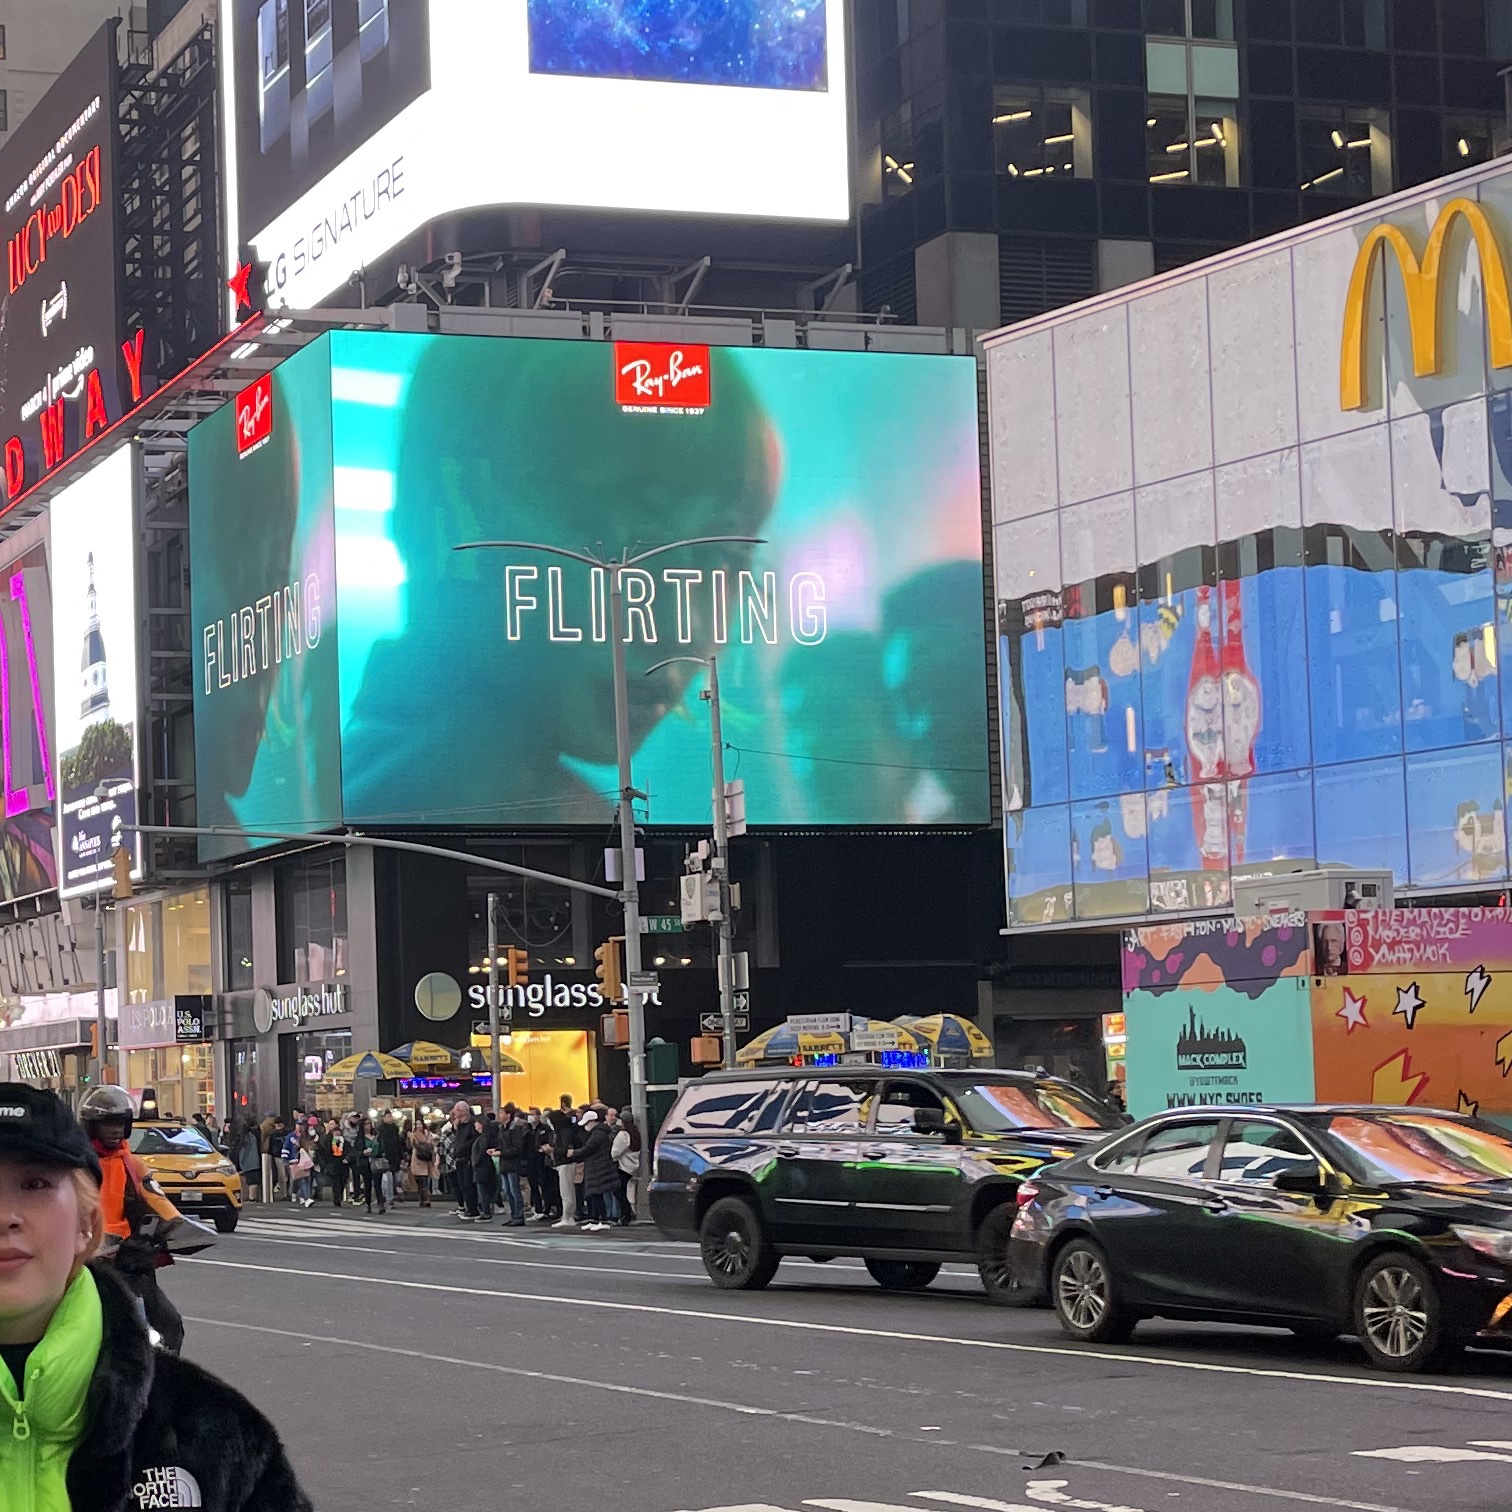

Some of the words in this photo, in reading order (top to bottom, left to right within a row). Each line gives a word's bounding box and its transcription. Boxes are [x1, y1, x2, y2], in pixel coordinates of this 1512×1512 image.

[56, 95, 100, 154] DOCUMENTARY
[7, 202, 46, 295] LUCY
[60, 145, 101, 239] DESI
[293, 155, 405, 276] SIGNATURE
[504, 565, 829, 647] FLIRTING
[203, 572, 321, 696] FLIRTING
[649, 919, 657, 930] W
[661, 919, 672, 931] 45
[271, 986, 320, 1028] sunglass
[321, 983, 344, 1015] hut
[177, 1017, 200, 1026] POLO
[178, 1025, 202, 1034] ASSN.
[1178, 1053, 1204, 1067] MACK
[1203, 1051, 1246, 1068] COMPLEX
[142, 1466, 177, 1481] THE
[131, 1479, 178, 1500] ORTH
[139, 1493, 179, 1510] FACE
